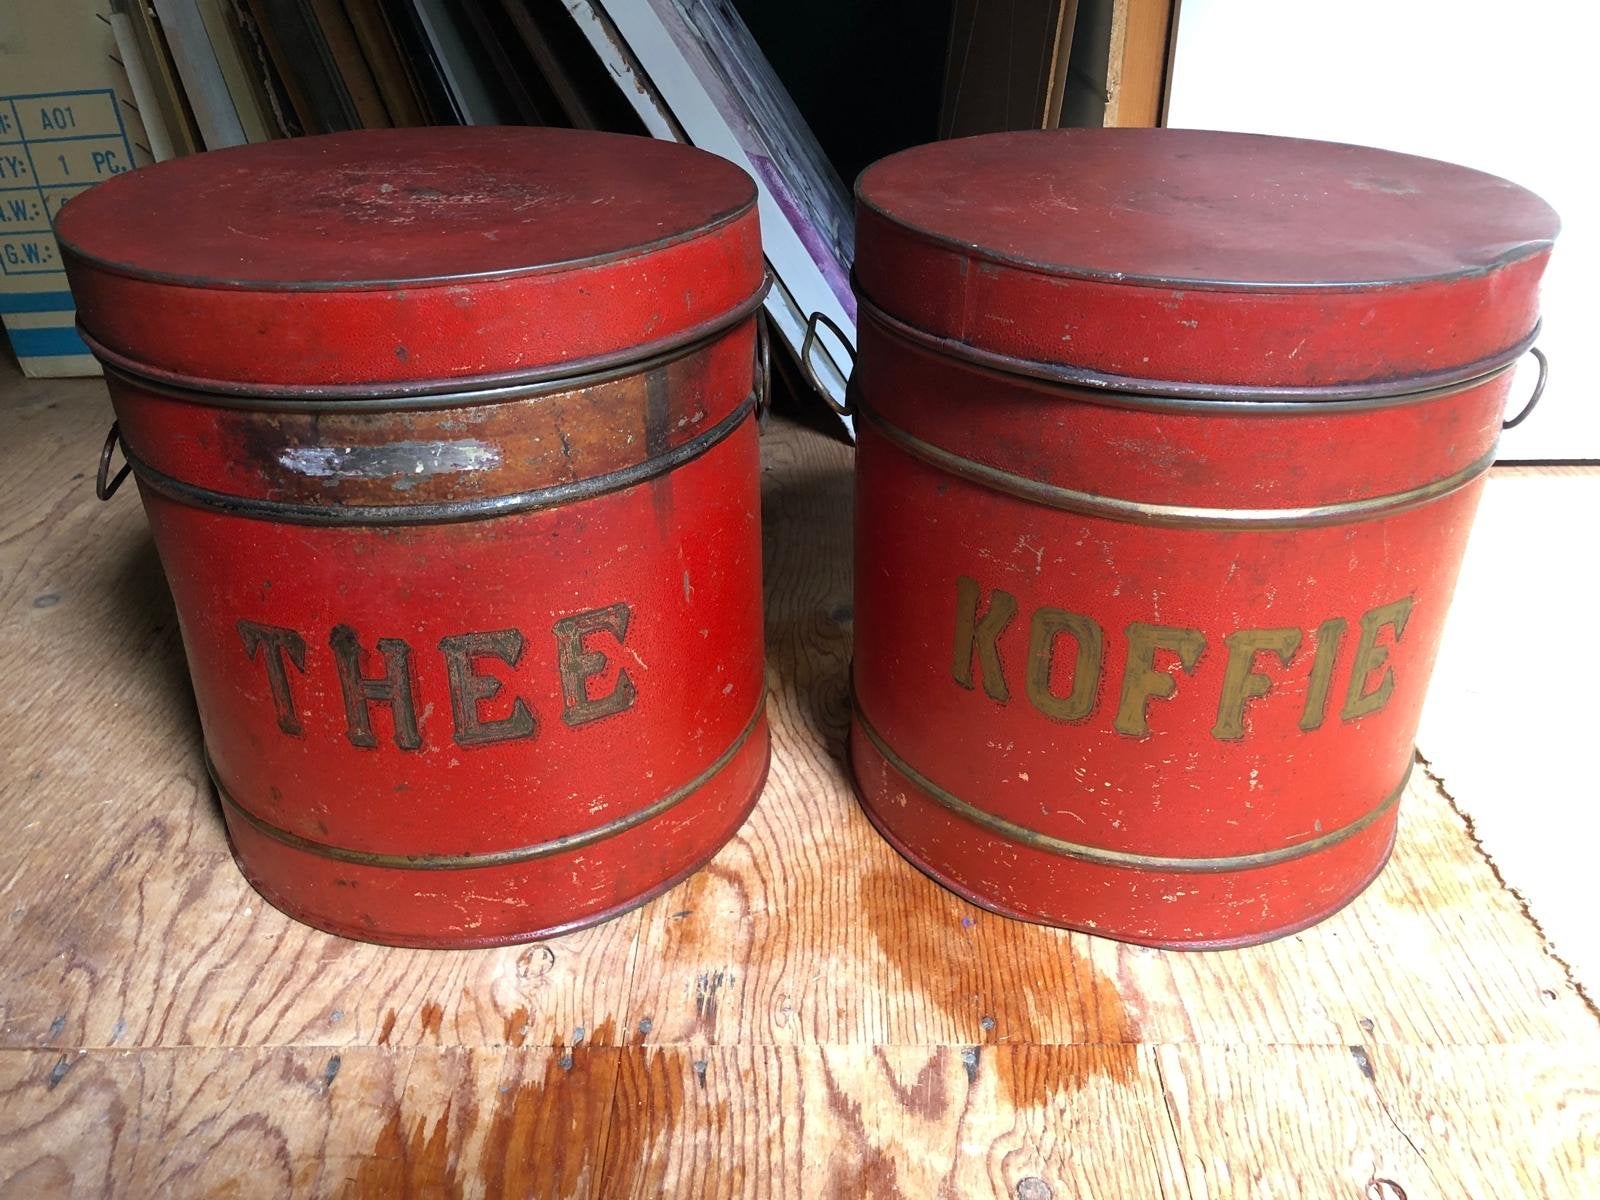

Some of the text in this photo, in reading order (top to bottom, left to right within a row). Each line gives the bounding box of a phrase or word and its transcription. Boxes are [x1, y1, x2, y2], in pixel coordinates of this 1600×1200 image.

[58, 155, 69, 175] 1
[92, 151, 127, 174] PC.
[4, 244, 52, 265] G.W.:
[236, 602, 636, 750] THEE
[951, 575, 1415, 741] KOFFIE
